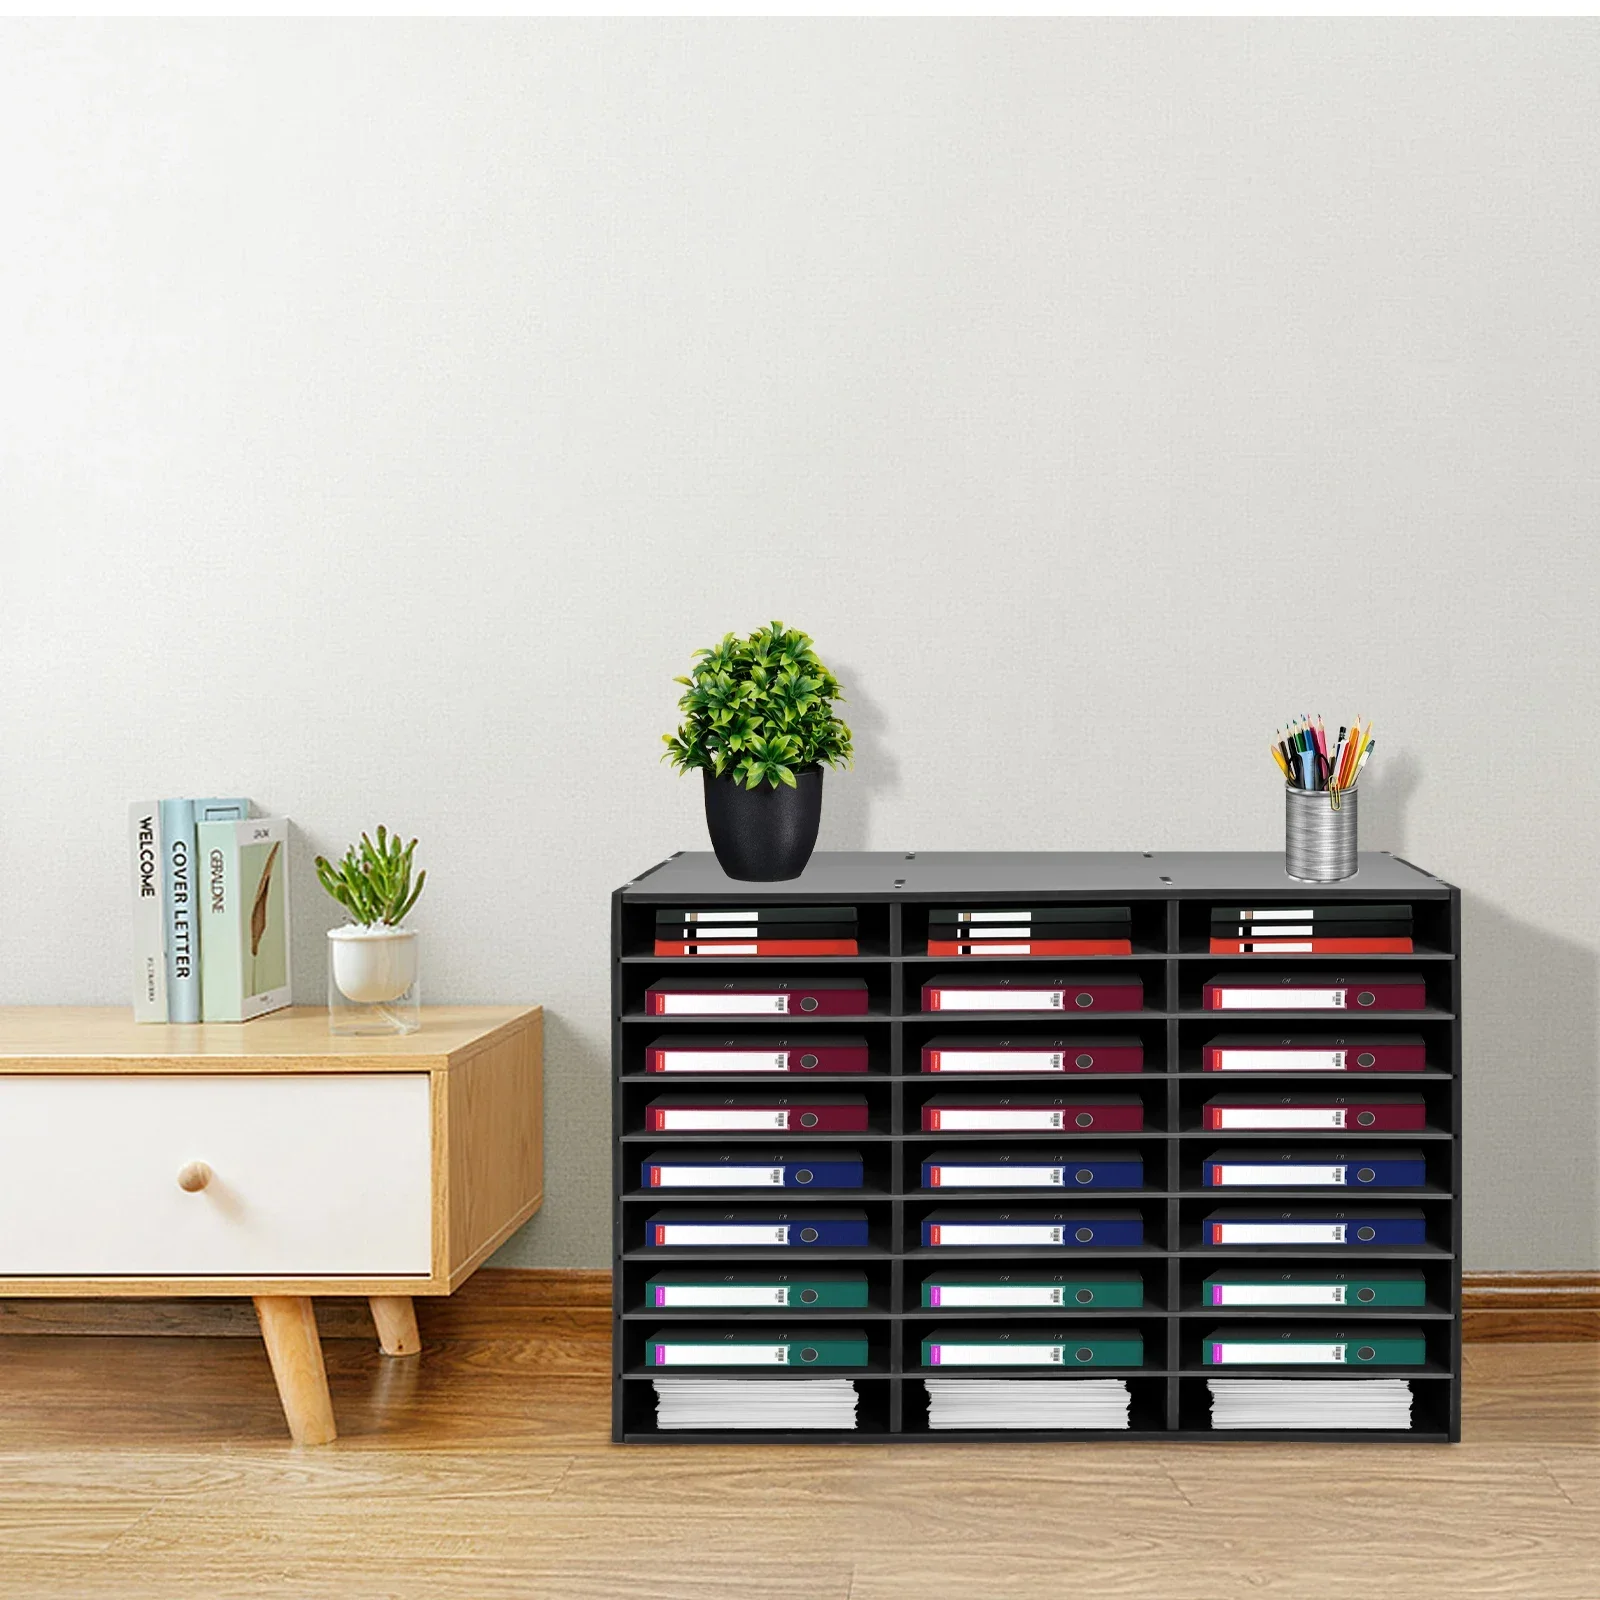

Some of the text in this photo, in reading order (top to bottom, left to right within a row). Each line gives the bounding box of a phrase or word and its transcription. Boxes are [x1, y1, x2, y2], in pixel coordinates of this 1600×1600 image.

[138, 816, 156, 898] WELCOME
[171, 840, 191, 979] COVER LETTER
